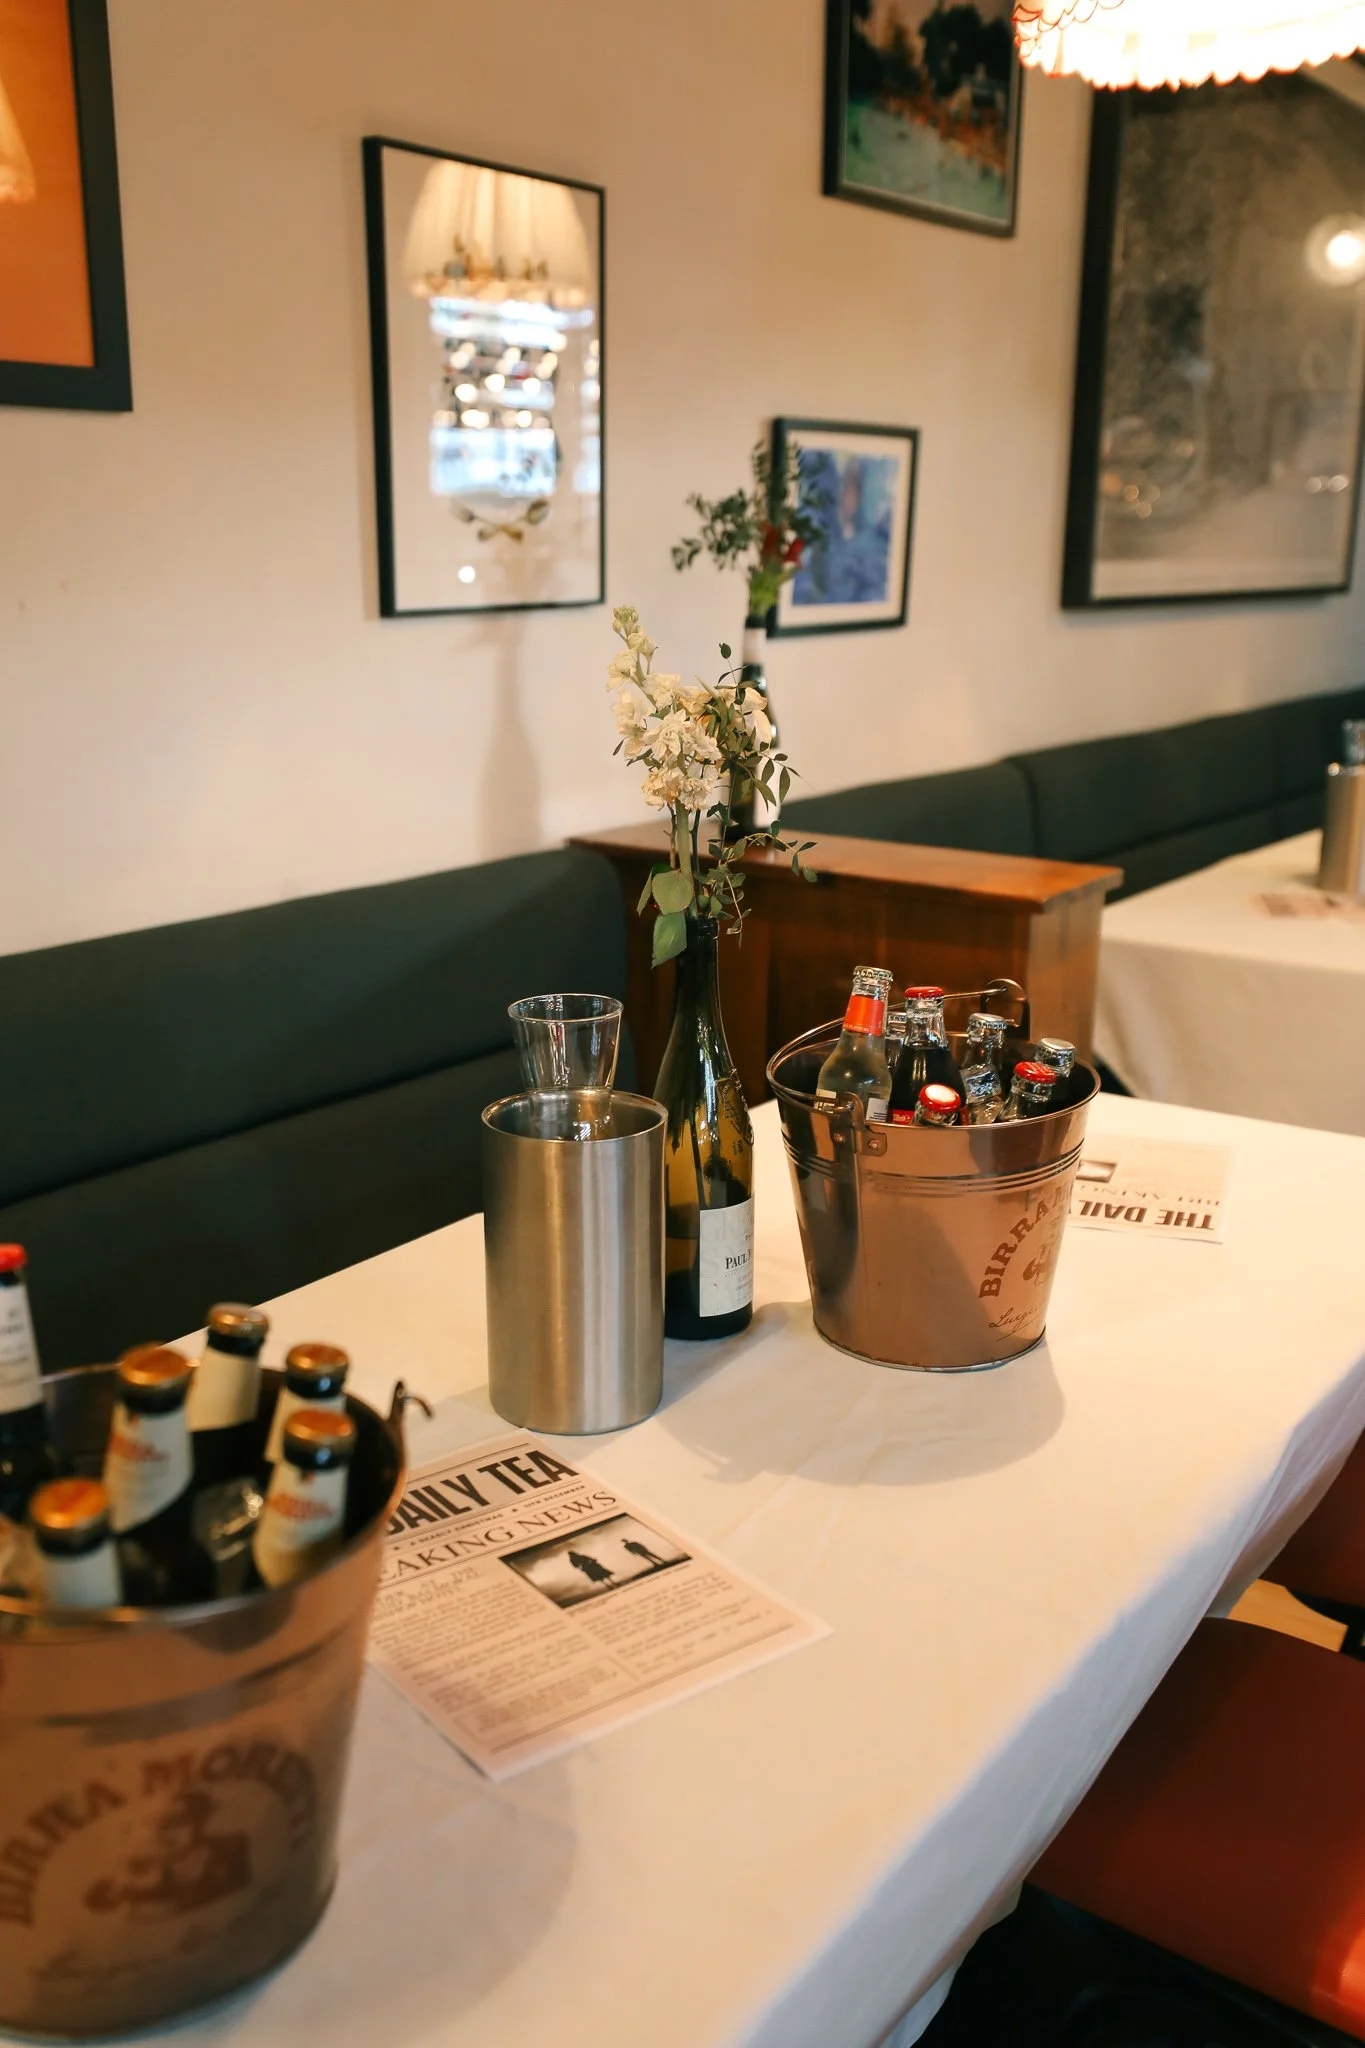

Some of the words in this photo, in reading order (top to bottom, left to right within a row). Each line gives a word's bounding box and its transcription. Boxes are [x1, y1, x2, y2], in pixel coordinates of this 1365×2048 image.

[1071, 1199, 1148, 1224] DAIL
[1154, 1209, 1215, 1231] THE
[725, 1253, 747, 1270] PAUL
[978, 1200, 1050, 1299] BIRRA
[476, 1449, 580, 1495] TEA
[543, 1485, 586, 1502] DECEMBER
[517, 1490, 617, 1534] NEWS
